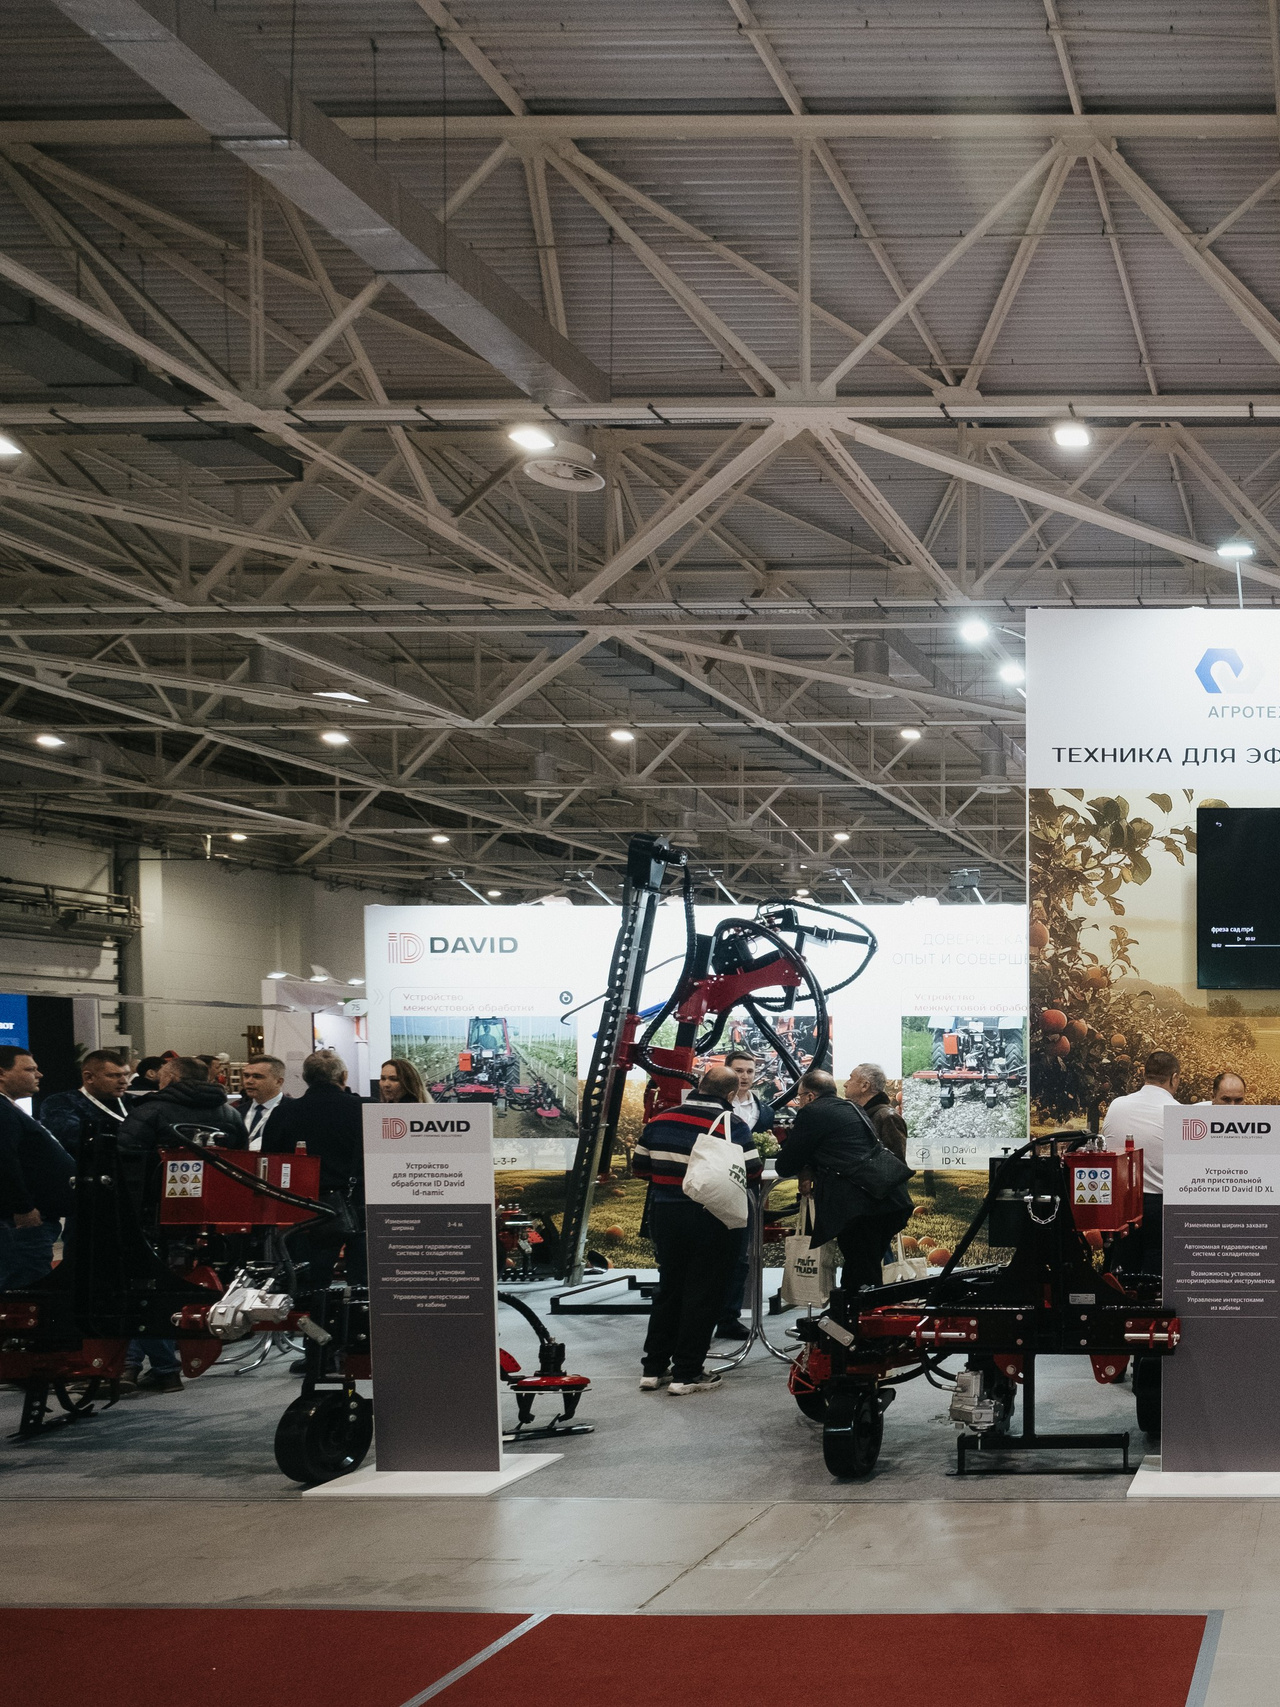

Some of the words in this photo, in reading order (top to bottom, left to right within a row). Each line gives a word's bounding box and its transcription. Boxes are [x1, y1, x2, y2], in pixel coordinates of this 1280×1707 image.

[1052, 747, 1172, 764] ТЕХНИКА
[1182, 748, 1235, 767] ДЛЯ
[1211, 926, 1229, 934] фреза
[430, 936, 518, 954] DAVID
[892, 953, 936, 964] ОПЫТ
[942, 953, 951, 964] И
[403, 993, 464, 1002] Устройство
[914, 993, 975, 1002] Устройство
[404, 1003, 474, 1012] межкустовой
[478, 1003, 534, 1012] обработки
[914, 1003, 986, 1012] межкустовой
[410, 1120, 471, 1132] DAVID
[1210, 1122, 1272, 1134] DAVID
[942, 1146, 950, 1154] ID
[952, 1146, 977, 1154] David
[406, 1162, 450, 1170] Устройство
[408, 1171, 463, 1179] приствольной
[1205, 1168, 1248, 1176] Устройство
[391, 1180, 432, 1188] обработки
[1179, 1185, 1220, 1193] обработки
